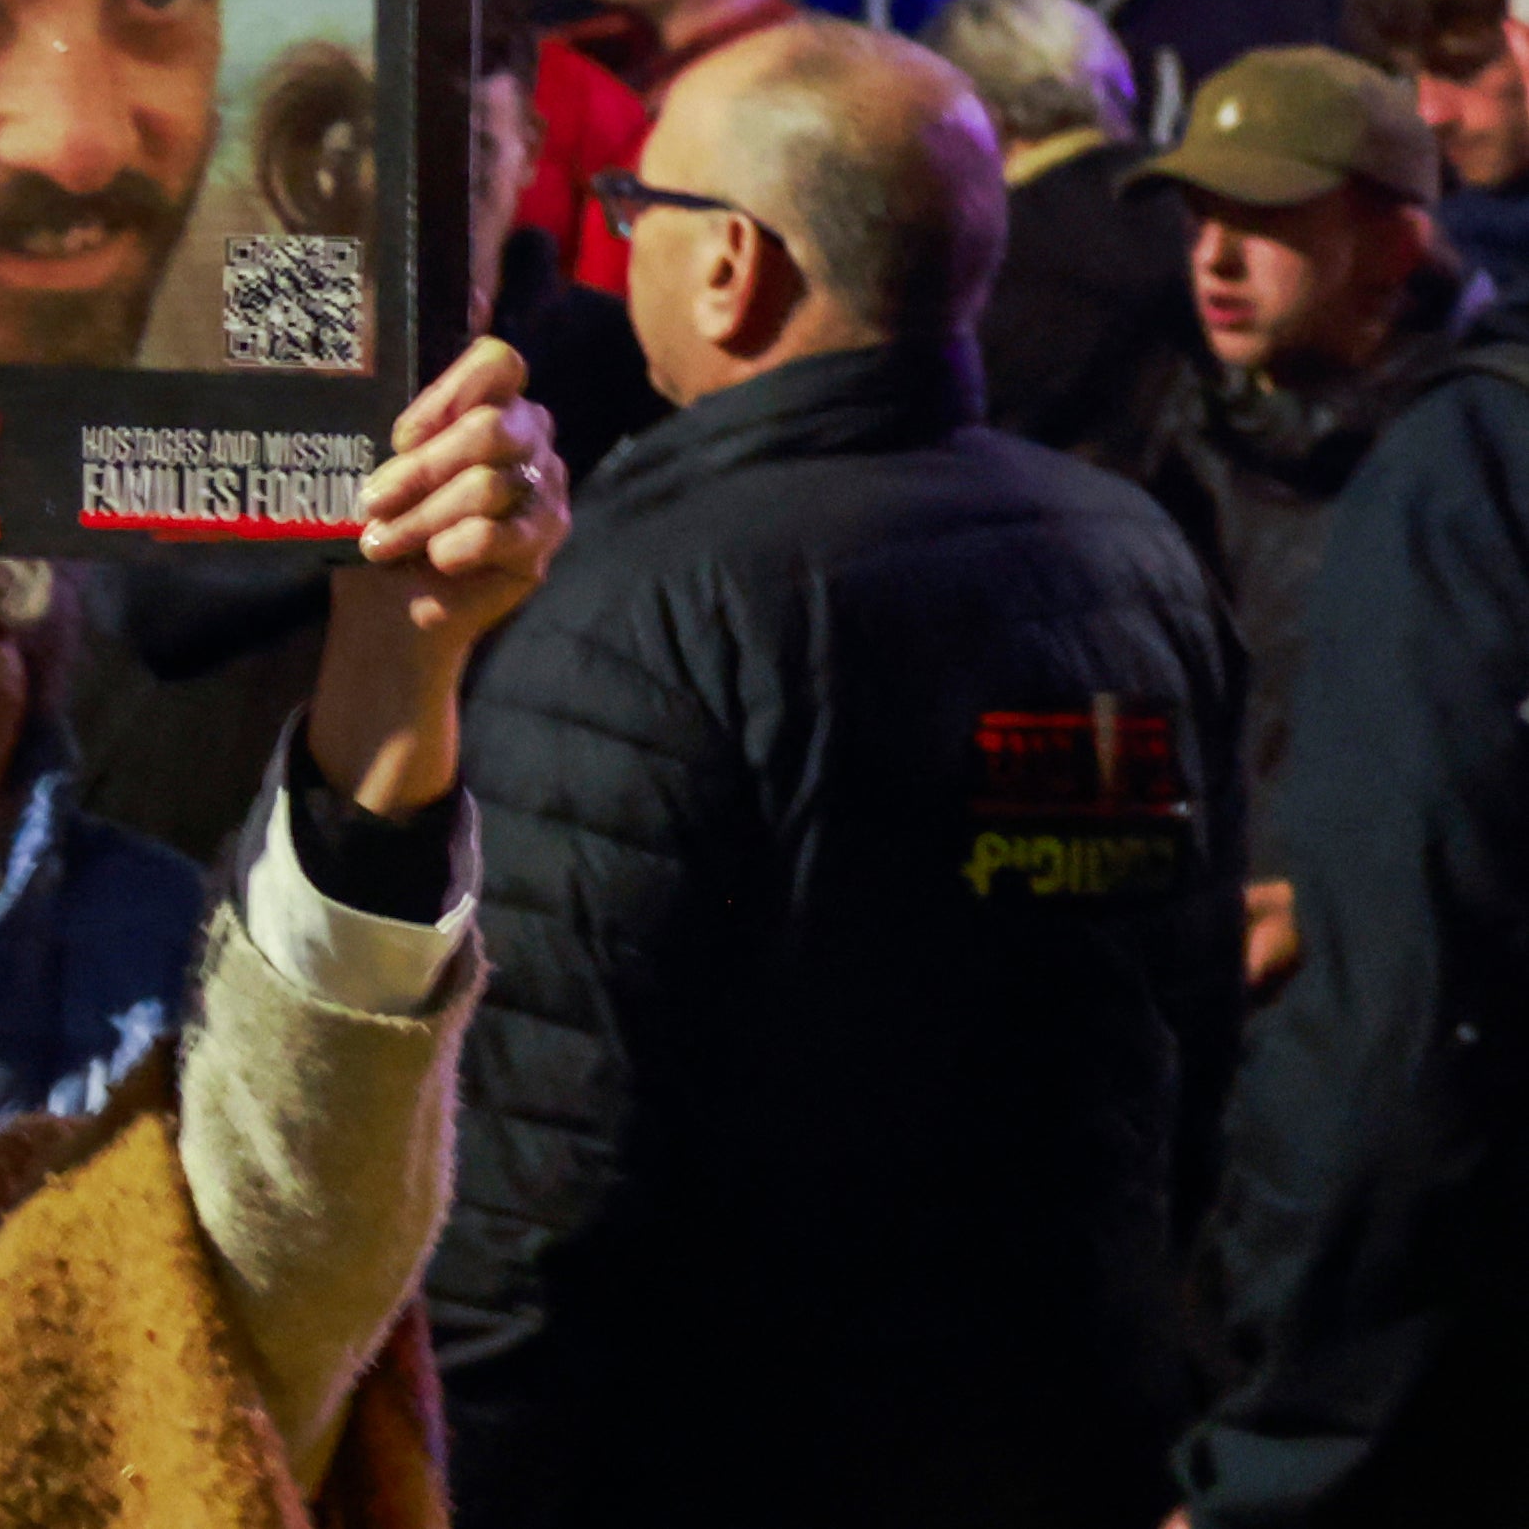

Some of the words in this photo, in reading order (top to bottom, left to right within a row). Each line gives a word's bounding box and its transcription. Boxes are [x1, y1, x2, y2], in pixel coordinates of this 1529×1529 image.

[82, 426, 208, 466] HOSTAGES
[208, 430, 258, 466] AND
[261, 432, 375, 474] MISSING
[83, 463, 240, 521] FAMILIES
